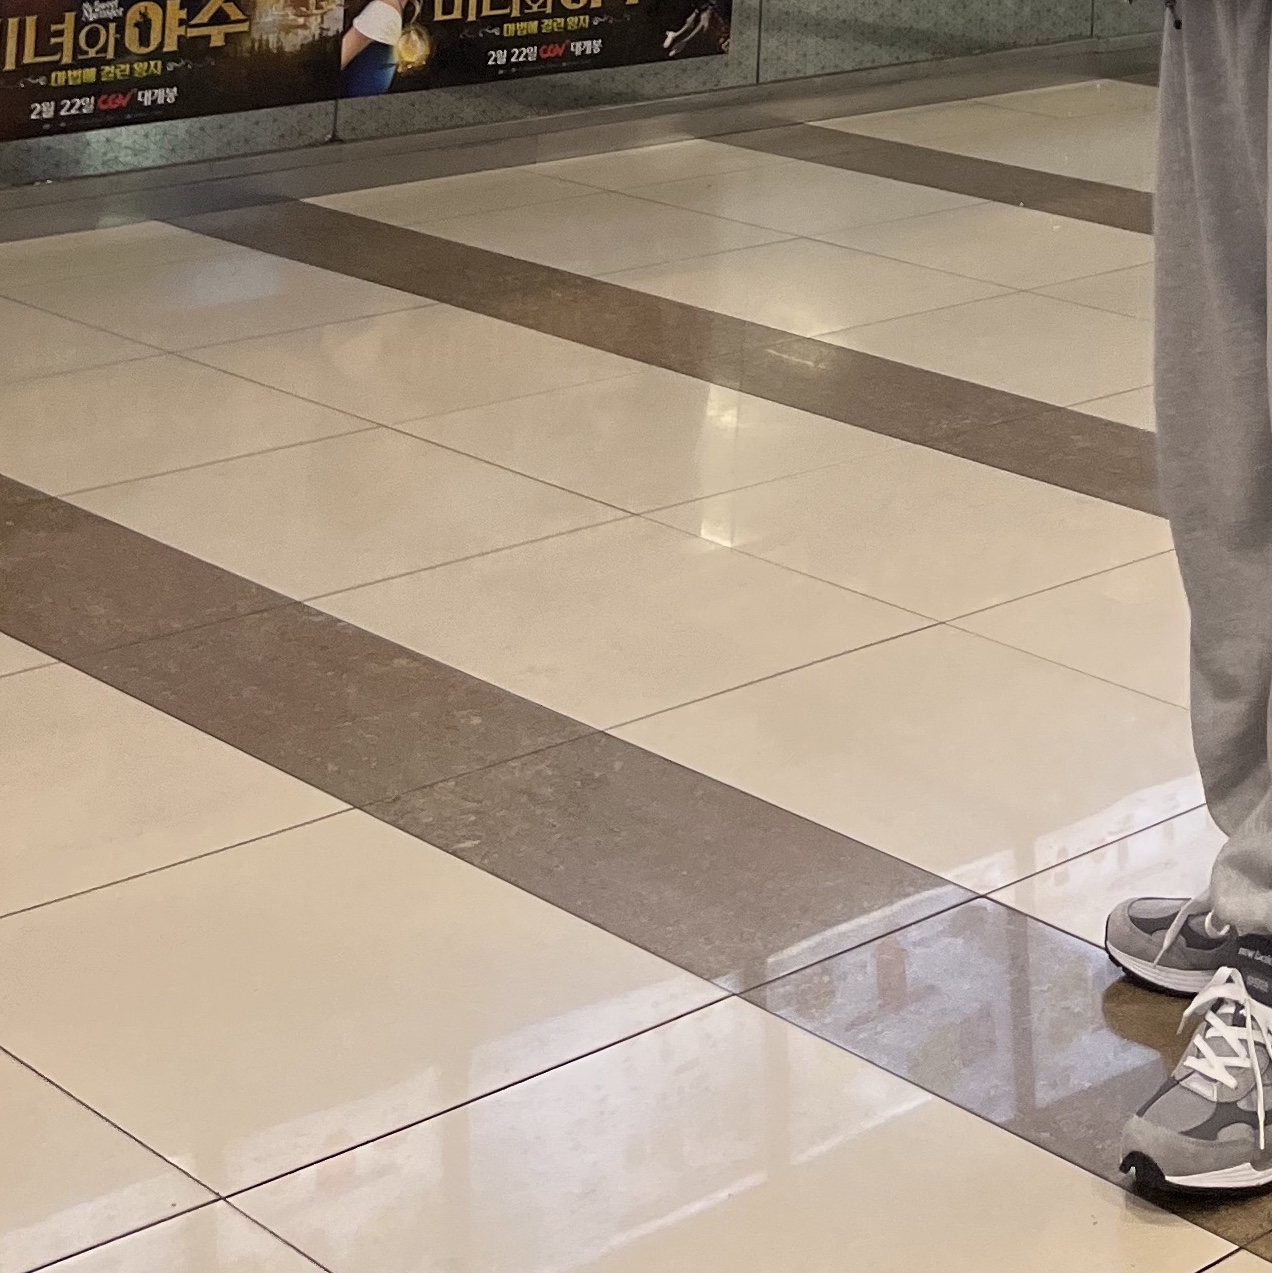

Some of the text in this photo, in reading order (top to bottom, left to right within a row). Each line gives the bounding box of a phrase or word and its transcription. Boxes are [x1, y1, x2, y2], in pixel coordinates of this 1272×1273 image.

[487, 38, 603, 66] 2월 22일 CGV 대개봉
[30, 85, 178, 120] 2월 22일 CGV 대개봉
